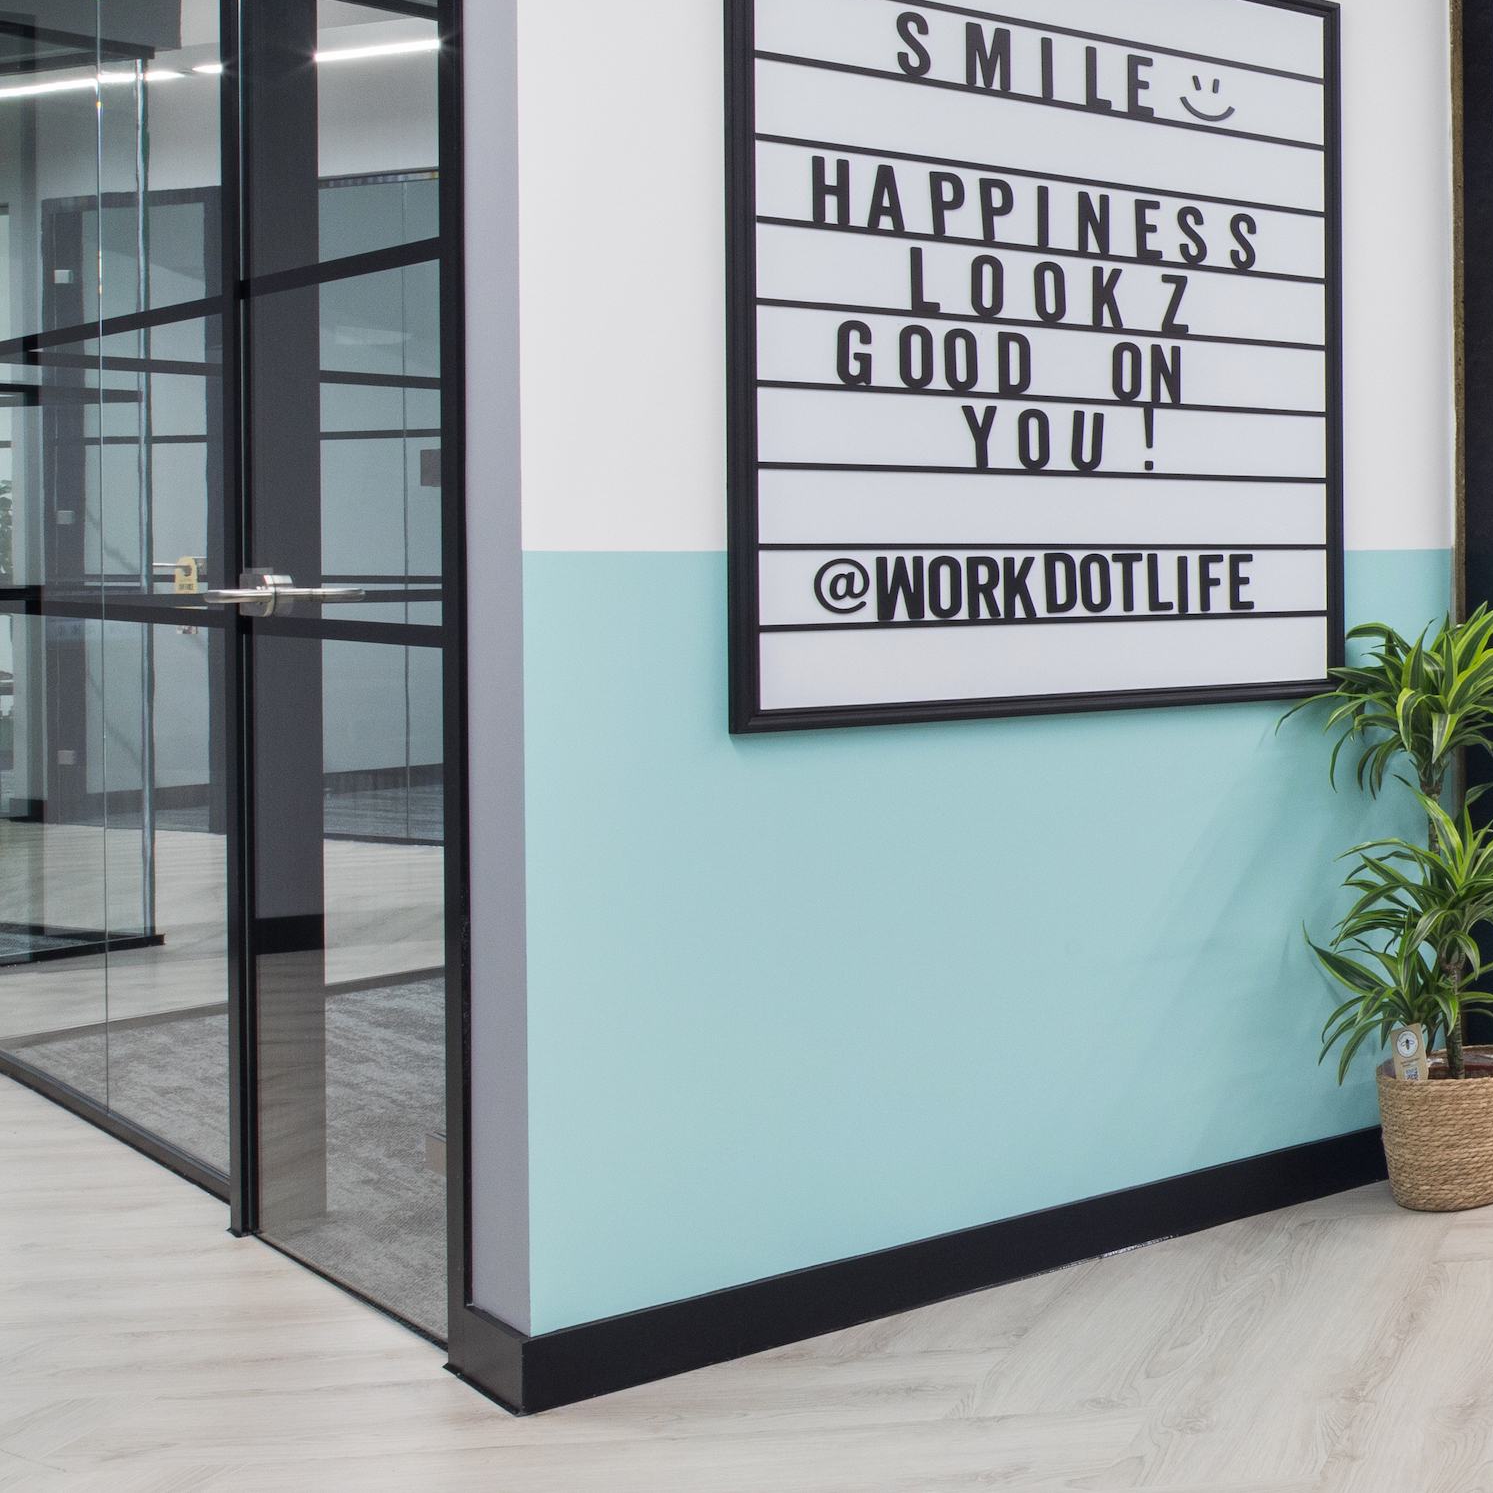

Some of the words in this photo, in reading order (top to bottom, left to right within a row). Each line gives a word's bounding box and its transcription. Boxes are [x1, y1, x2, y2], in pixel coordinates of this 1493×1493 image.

[896, 11, 1155, 118] SMILE
[811, 155, 1258, 269] HAPPINESS
[910, 247, 1189, 334] LOOKZ
[836, 320, 1032, 395] GOOD
[1111, 341, 1182, 404] ON
[813, 552, 1255, 622] @WORKDOTLIFE
